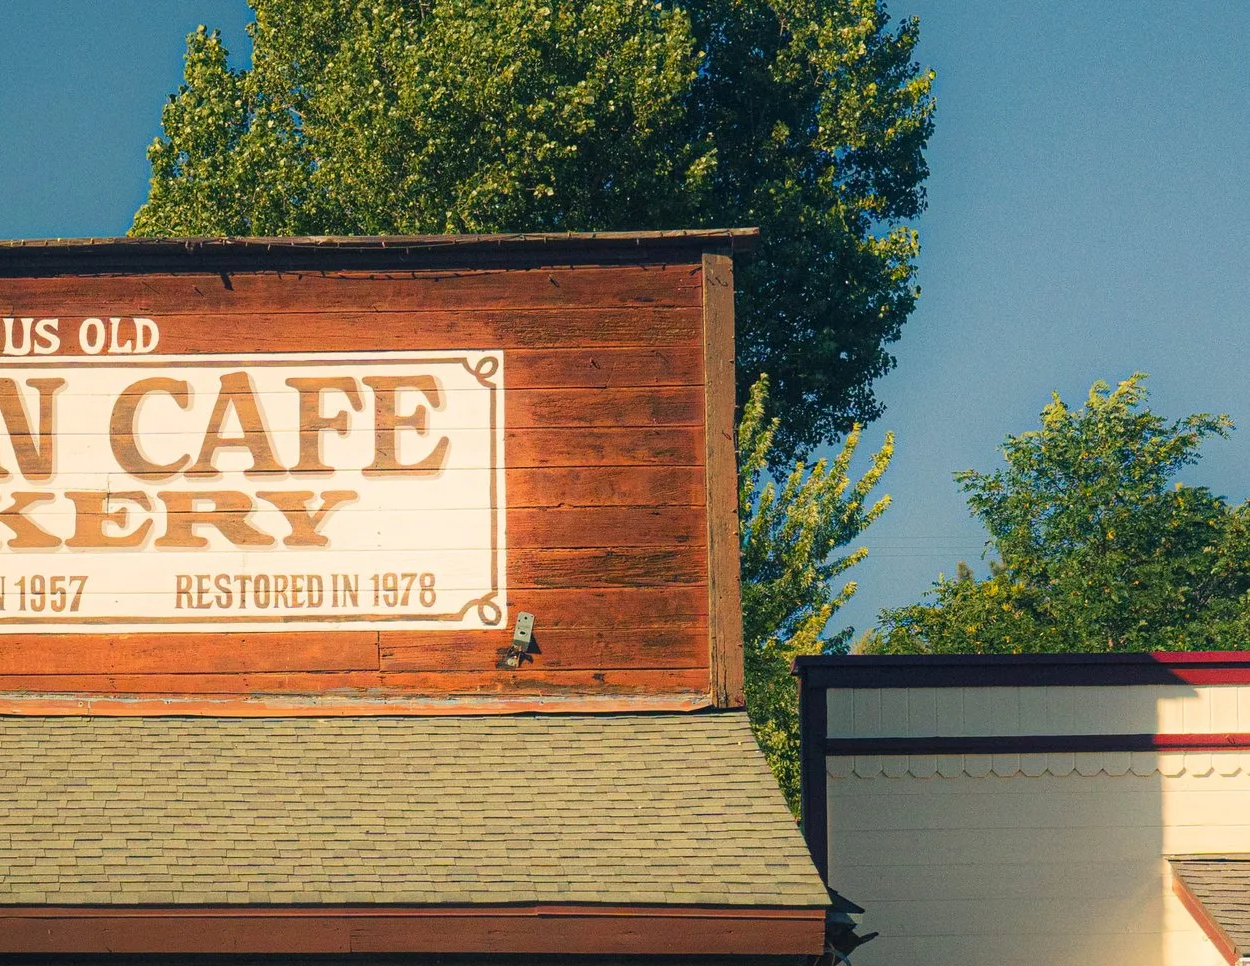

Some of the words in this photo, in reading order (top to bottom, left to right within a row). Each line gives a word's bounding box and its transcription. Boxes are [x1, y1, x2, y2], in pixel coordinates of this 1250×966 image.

[78, 317, 161, 355] OLD
[108, 370, 451, 482] CAFE
[14, 575, 89, 613] 1957
[175, 573, 324, 610] RESTORED
[330, 574, 360, 608] IN
[370, 573, 437, 609] 1978
